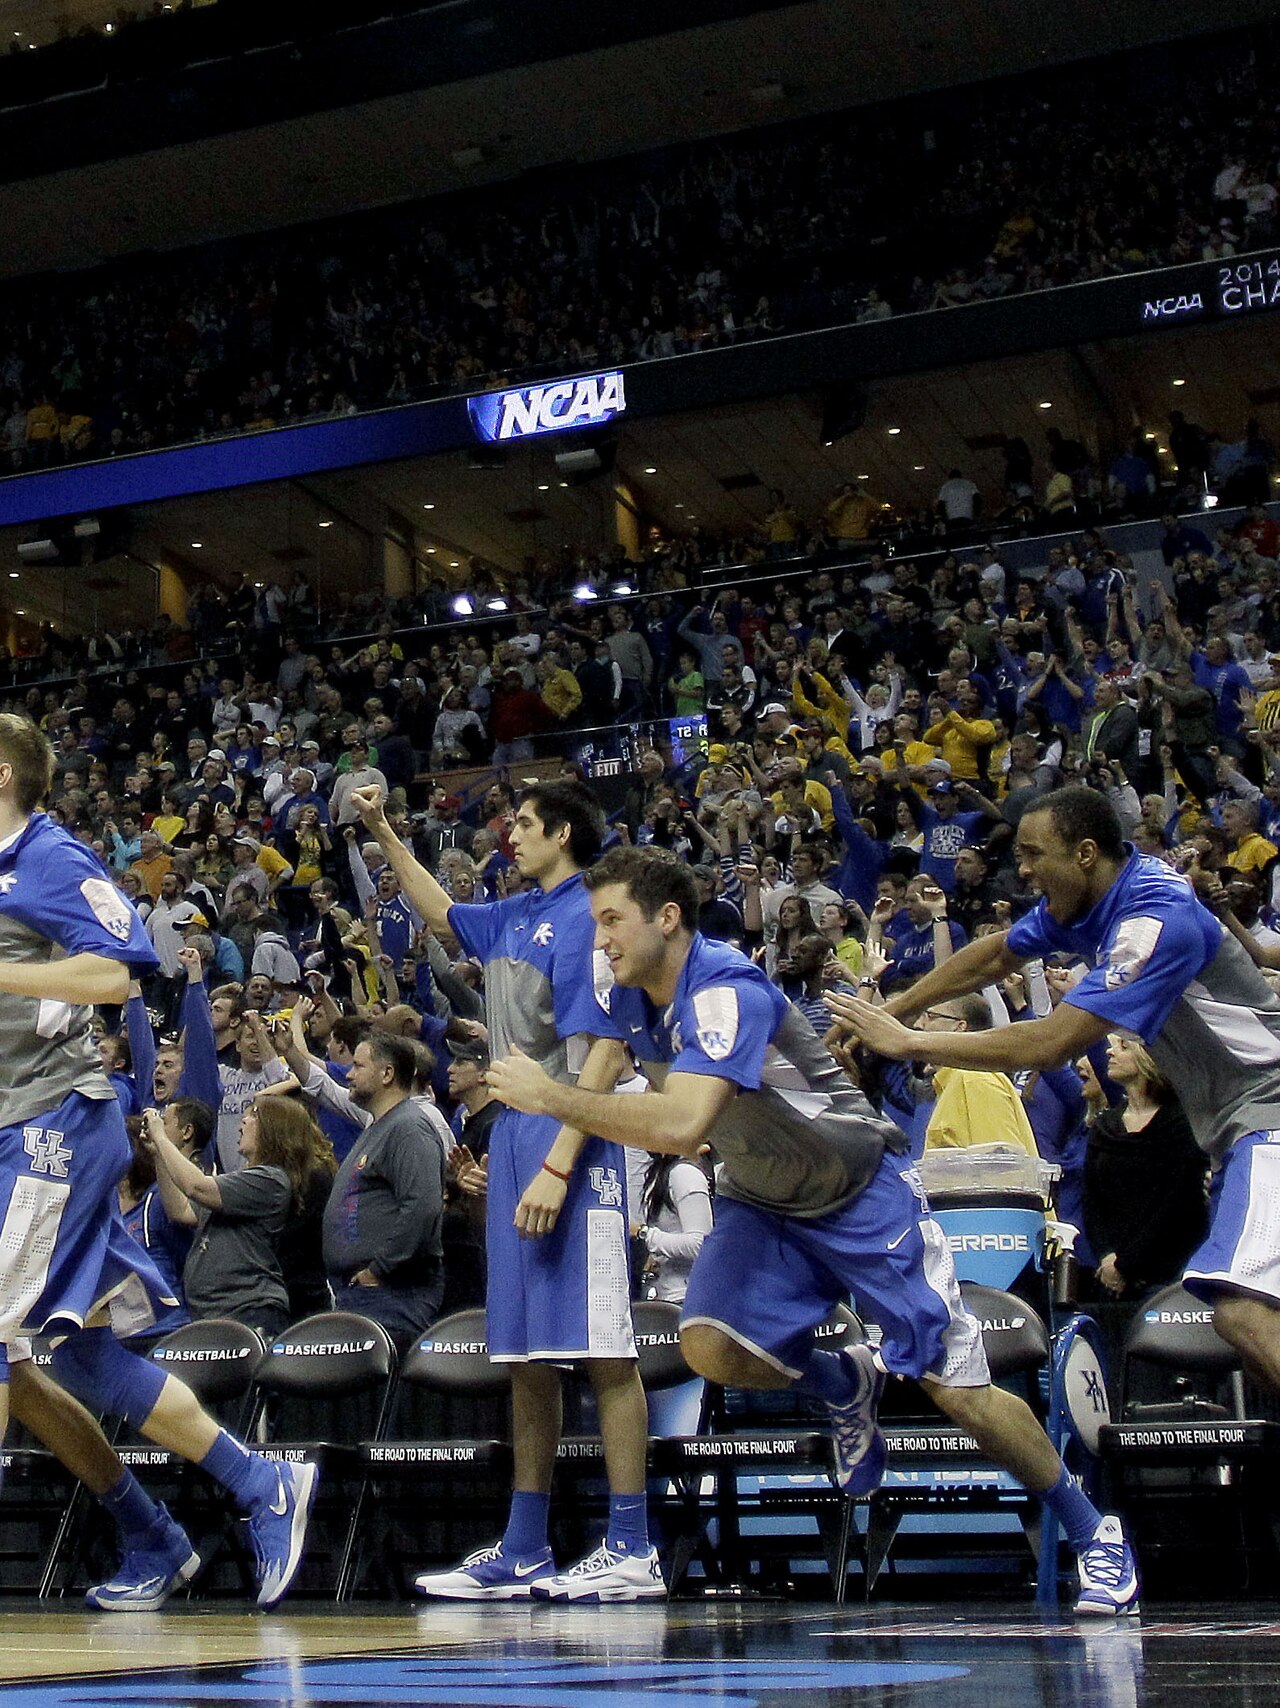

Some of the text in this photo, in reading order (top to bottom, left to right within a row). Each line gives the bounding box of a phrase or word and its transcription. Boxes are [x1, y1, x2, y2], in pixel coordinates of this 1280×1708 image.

[1219, 259, 1280, 286] 2014
[1143, 293, 1203, 318] NCAA
[499, 374, 626, 440] NCAA
[23, 1127, 73, 1178] UK
[1161, 1310, 1214, 1324] BASKE
[285, 1341, 362, 1356] BASKETBALL
[434, 1342, 487, 1354] BASKET
[165, 1349, 238, 1362] BASKETBALL
[885, 1438, 903, 1451] THE
[904, 1438, 927, 1450] ROAD
[928, 1438, 940, 1449] TO
[941, 1437, 959, 1449] THE
[1119, 1429, 1244, 1446] THE ROAD TO THE FINAL FOUR
[370, 1447, 474, 1461] THE ROAD TO THE FINAL FOUR
[568, 1445, 578, 1457] TO
[579, 1444, 595, 1457] THE
[683, 1440, 795, 1456] THE ROAD TO THE FINAL FOUR
[120, 1452, 168, 1465] THE FINAL FOUR
[285, 1450, 304, 1462] FOUR
